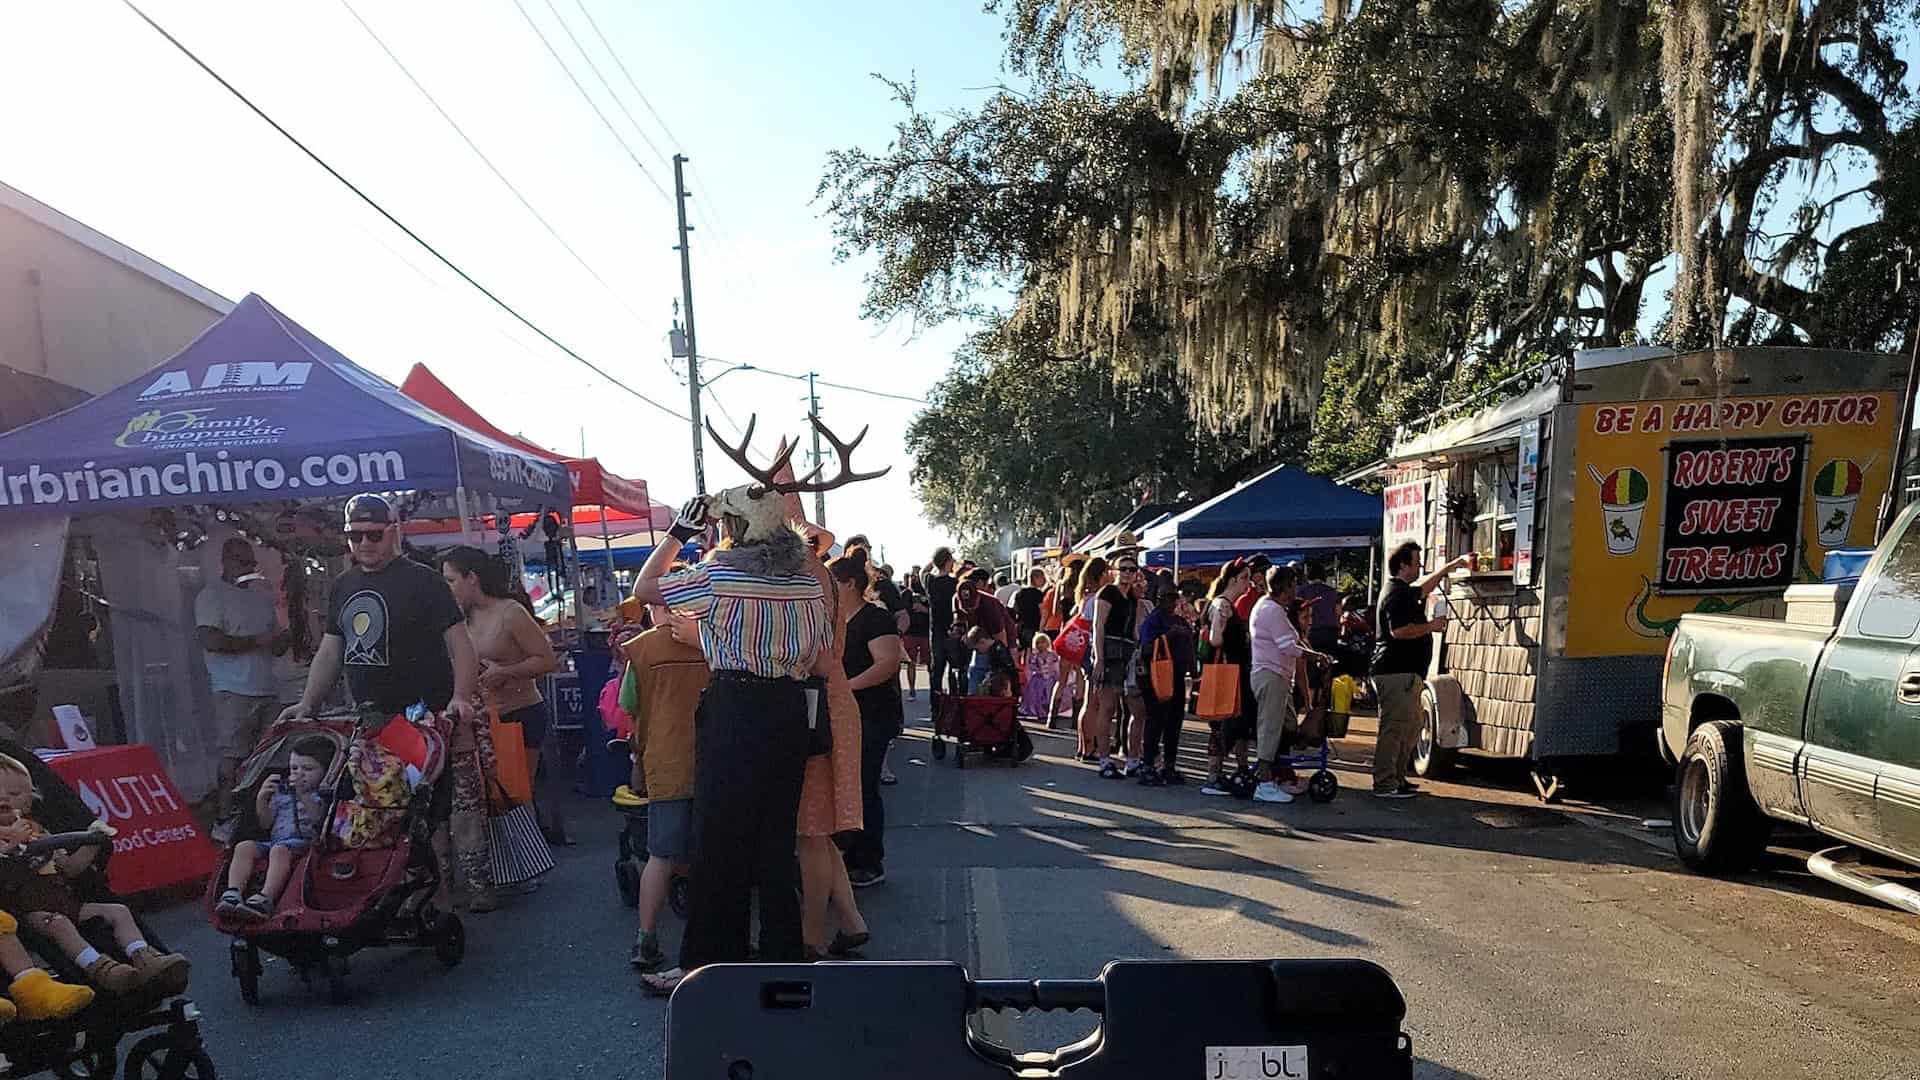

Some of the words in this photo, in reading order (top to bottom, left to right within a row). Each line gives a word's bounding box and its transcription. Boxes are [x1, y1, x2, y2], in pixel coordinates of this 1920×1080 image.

[140, 361, 313, 397] AIM
[115, 419, 288, 447] Chiropractic
[1594, 407, 1635, 433] BE
[1642, 404, 1664, 432] A
[1672, 401, 1774, 430] HAPPY
[1781, 395, 1880, 426] GATOR
[0, 449, 406, 506] rbrianchiro.com
[1673, 447, 1796, 488] ROBERT'S
[1679, 498, 1782, 535] SWEET
[1665, 544, 1787, 583] TREATS
